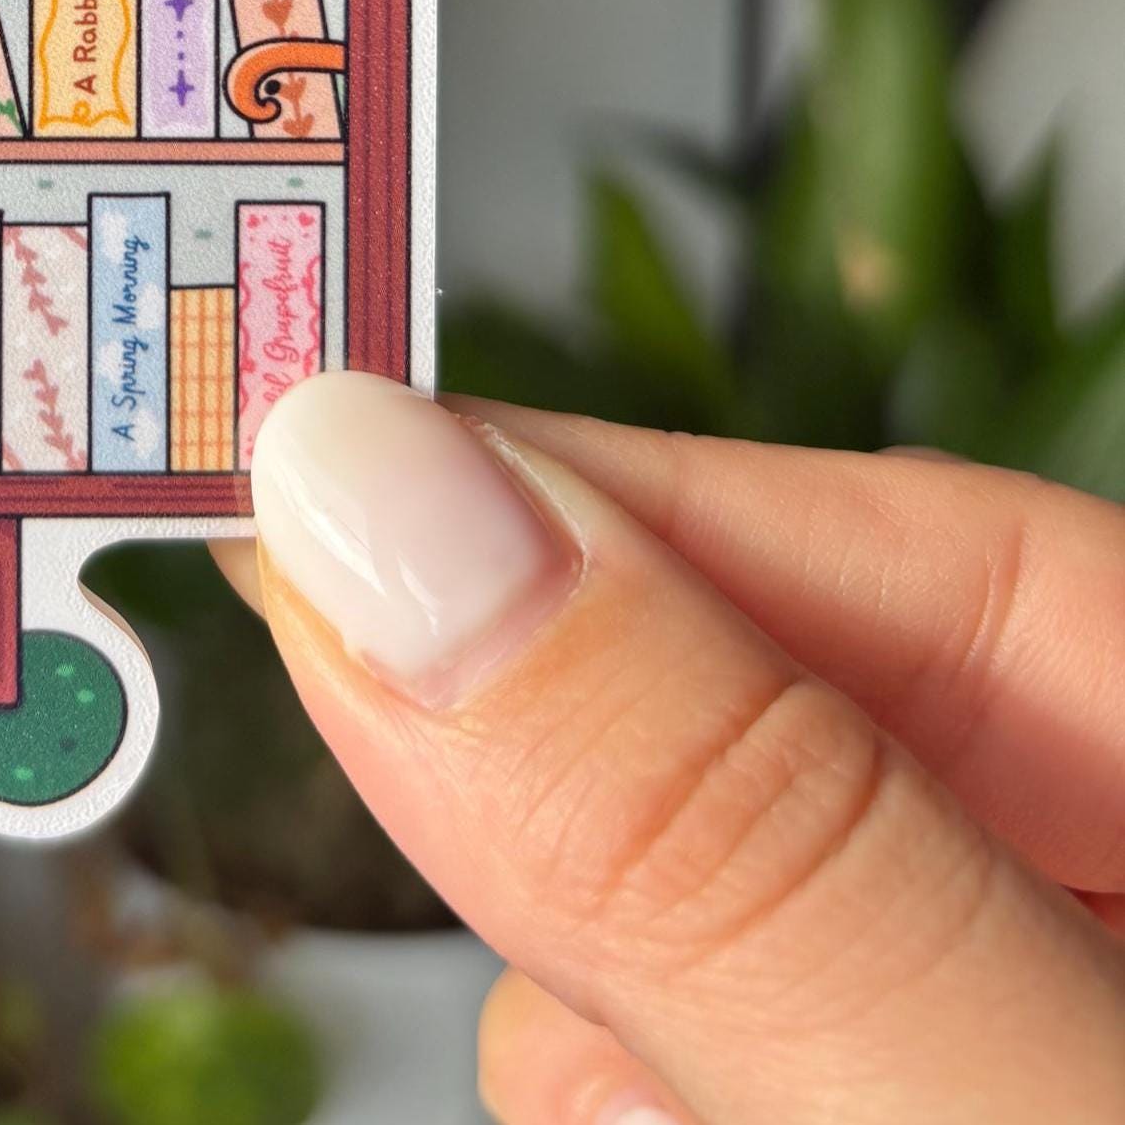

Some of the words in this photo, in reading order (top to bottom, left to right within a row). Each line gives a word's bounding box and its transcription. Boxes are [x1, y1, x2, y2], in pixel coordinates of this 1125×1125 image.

[73, 73, 97, 95] A
[111, 234, 151, 326] Morning
[261, 235, 300, 364] Grapefruit
[111, 336, 150, 411] Spring
[111, 423, 136, 442] A
